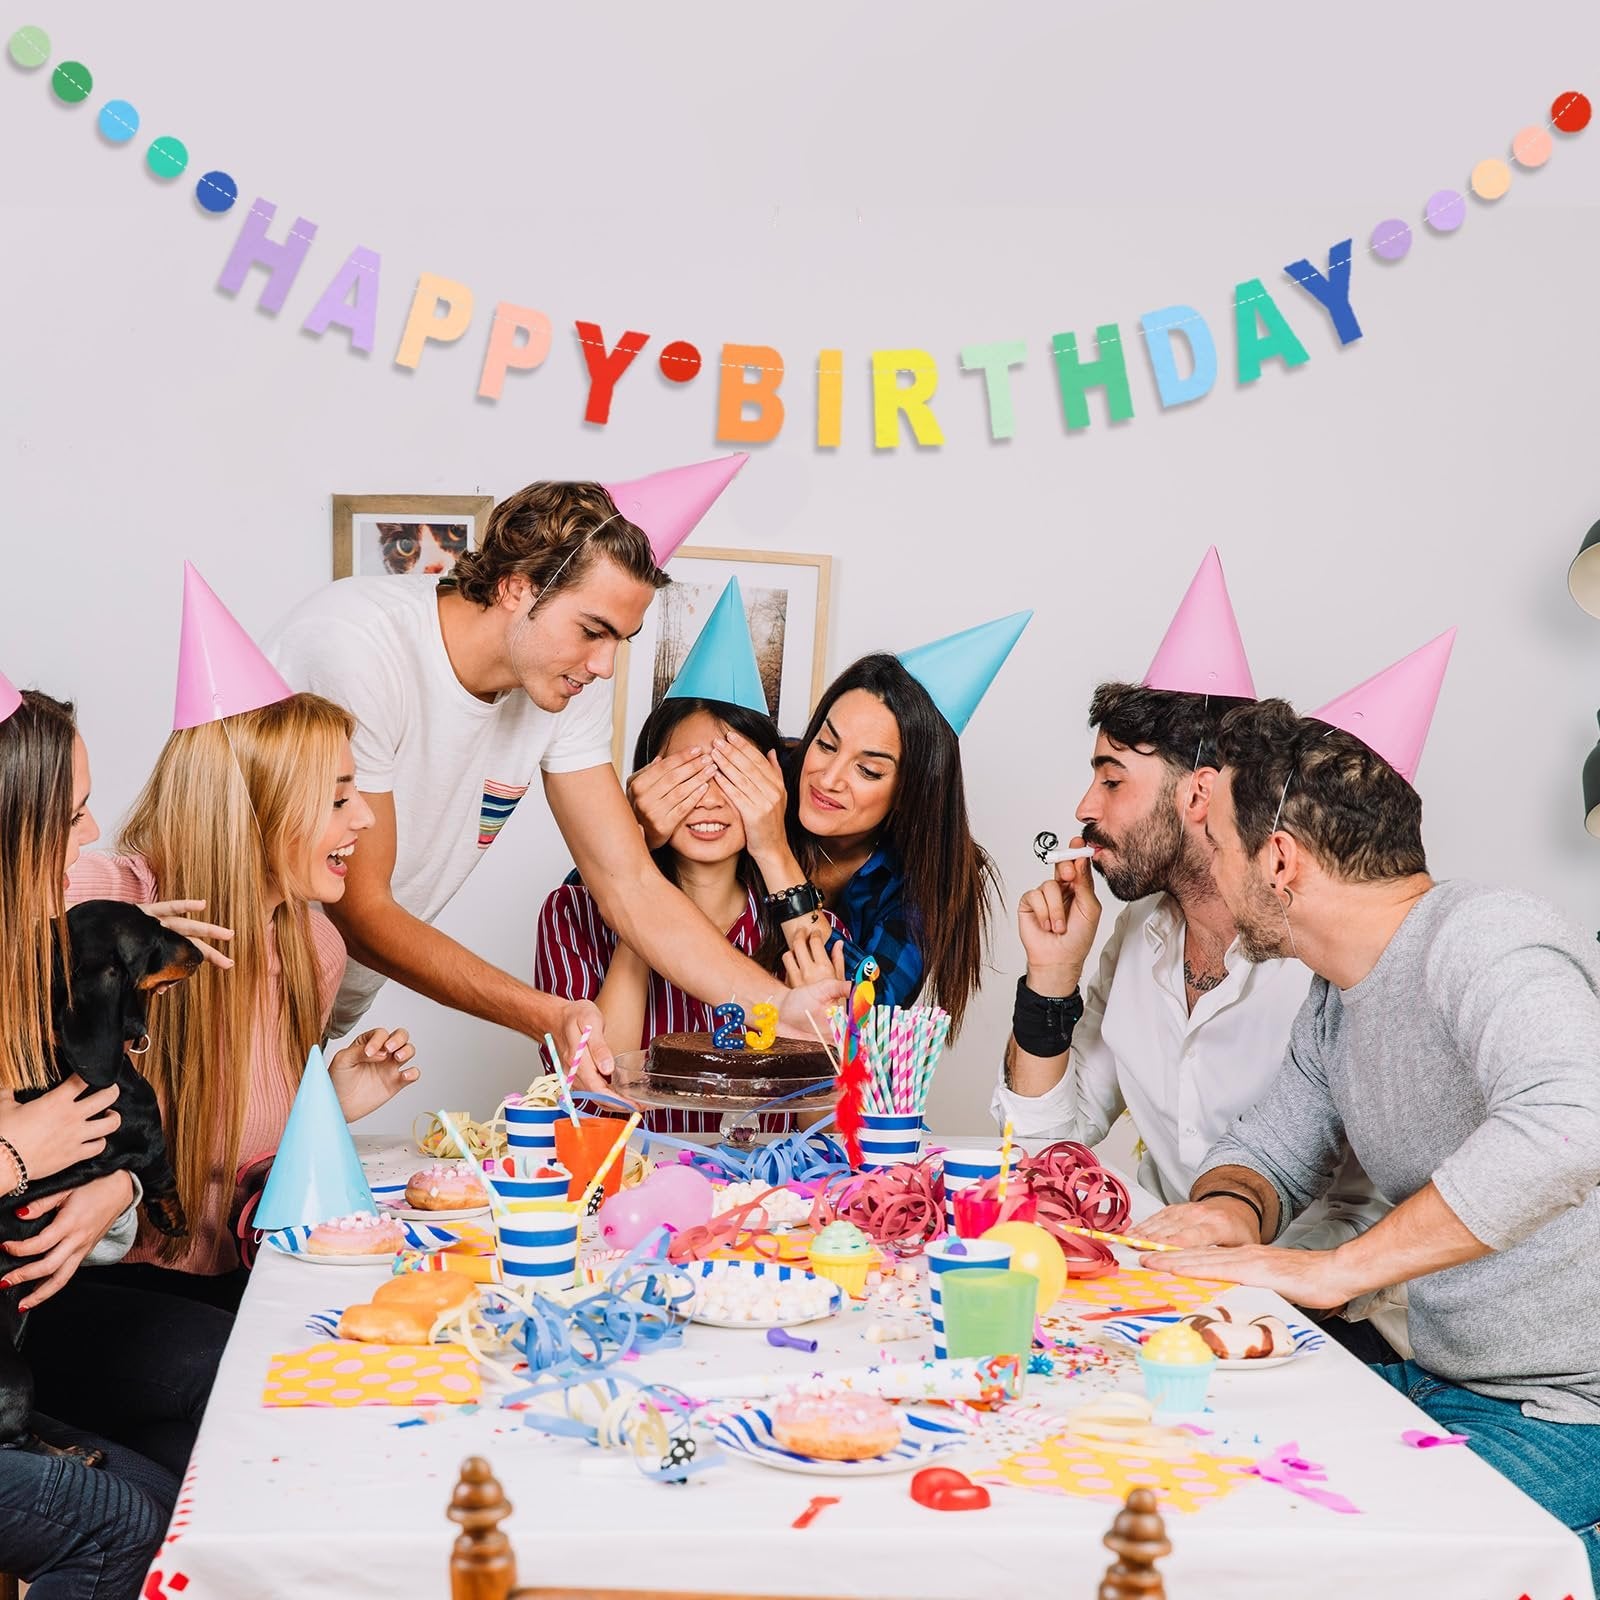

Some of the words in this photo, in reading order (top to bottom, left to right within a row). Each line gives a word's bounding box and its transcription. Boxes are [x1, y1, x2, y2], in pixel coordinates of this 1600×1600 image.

[217, 198, 650, 425] HAPPY
[716, 238, 1363, 448] BIRTHDAY
[713, 1003, 778, 1050] 23
